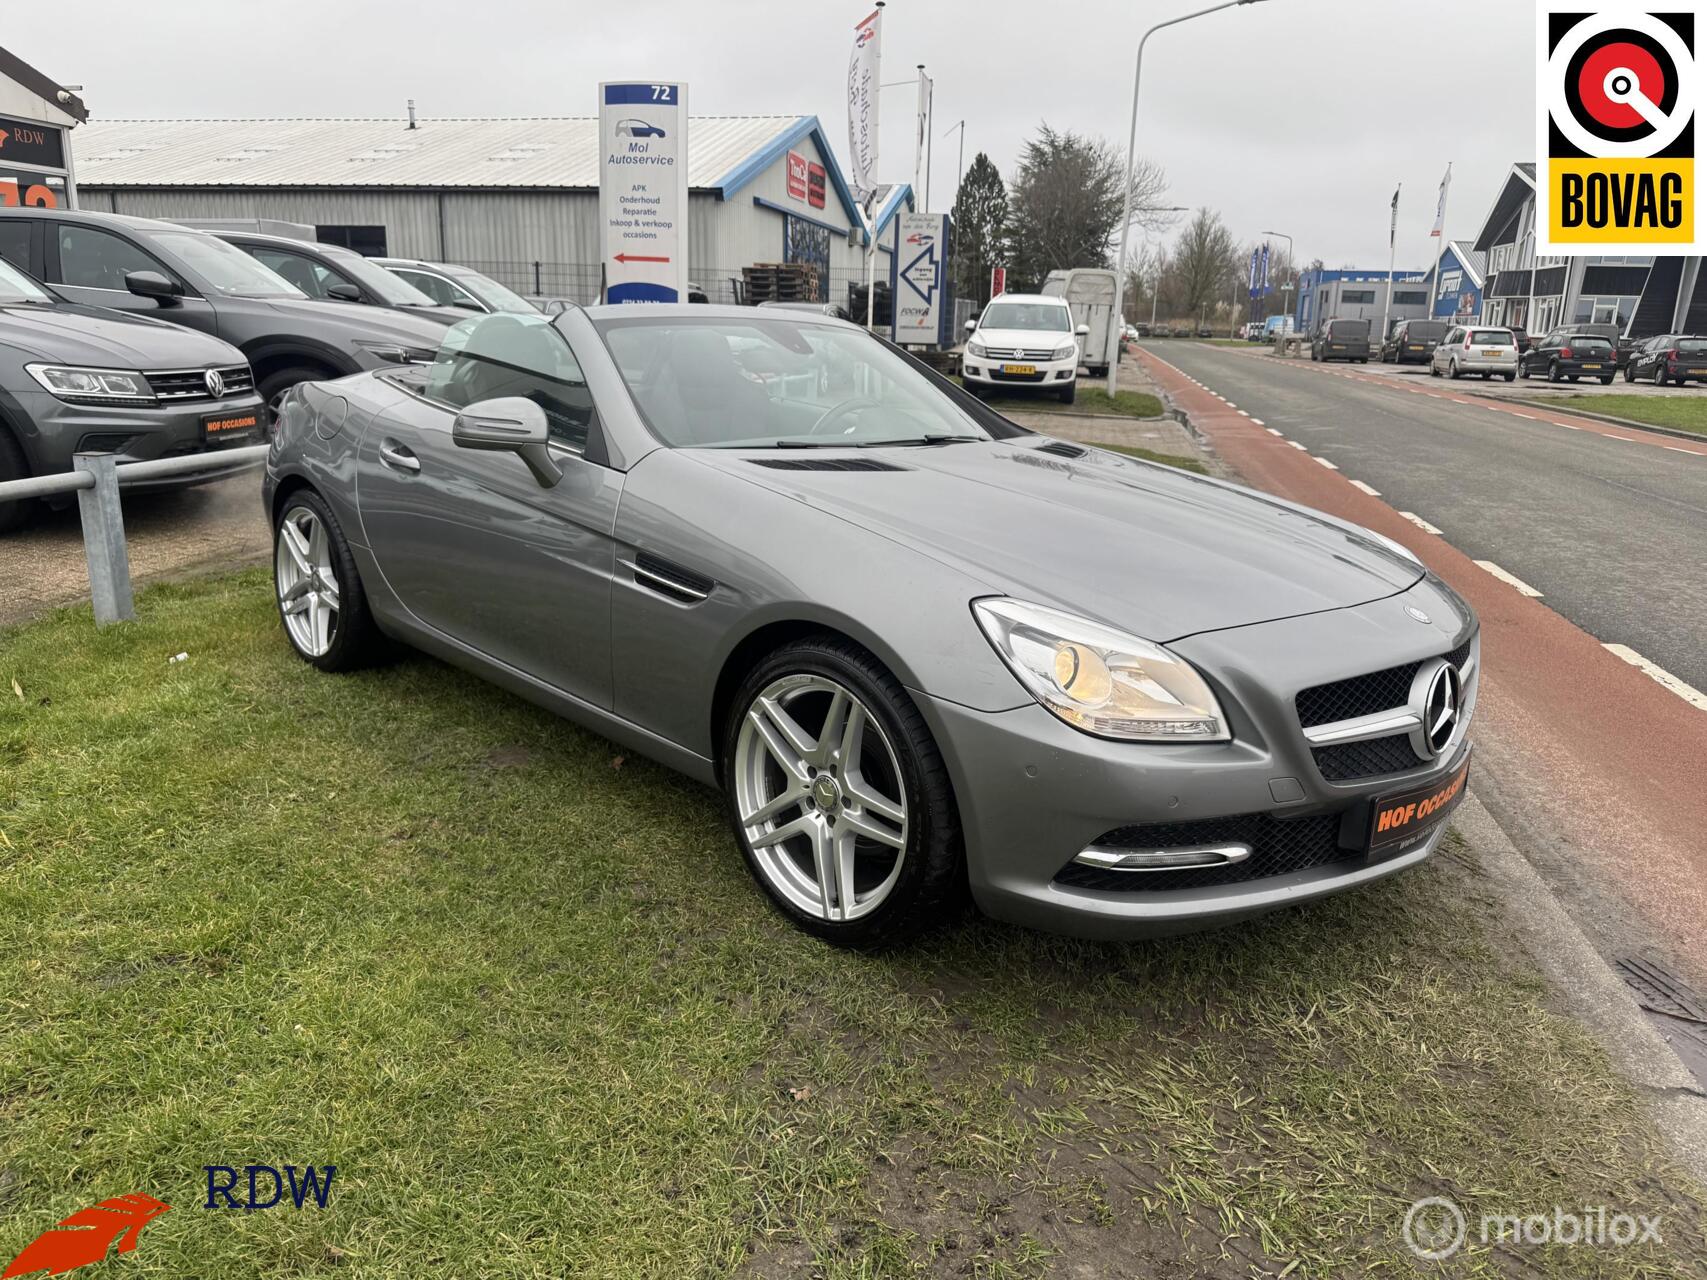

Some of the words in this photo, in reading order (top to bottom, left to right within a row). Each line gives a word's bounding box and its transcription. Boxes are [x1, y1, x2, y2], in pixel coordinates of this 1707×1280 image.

[651, 86, 671, 100] 72
[14, 127, 45, 145] RDW
[628, 142, 649, 153] Mol
[608, 154, 674, 166] Autoservice
[632, 184, 647, 192] APK
[619, 196, 660, 204] Onderhoud
[623, 207, 657, 217] Reparatie
[609, 219, 633, 229] Inkoop
[634, 220, 641, 228] &
[641, 220, 672, 229] verkoop
[623, 231, 657, 239] occasions
[207, 421, 221, 431] HOF
[221, 416, 256, 429] OCCASIONS
[1377, 802, 1416, 832] HOF
